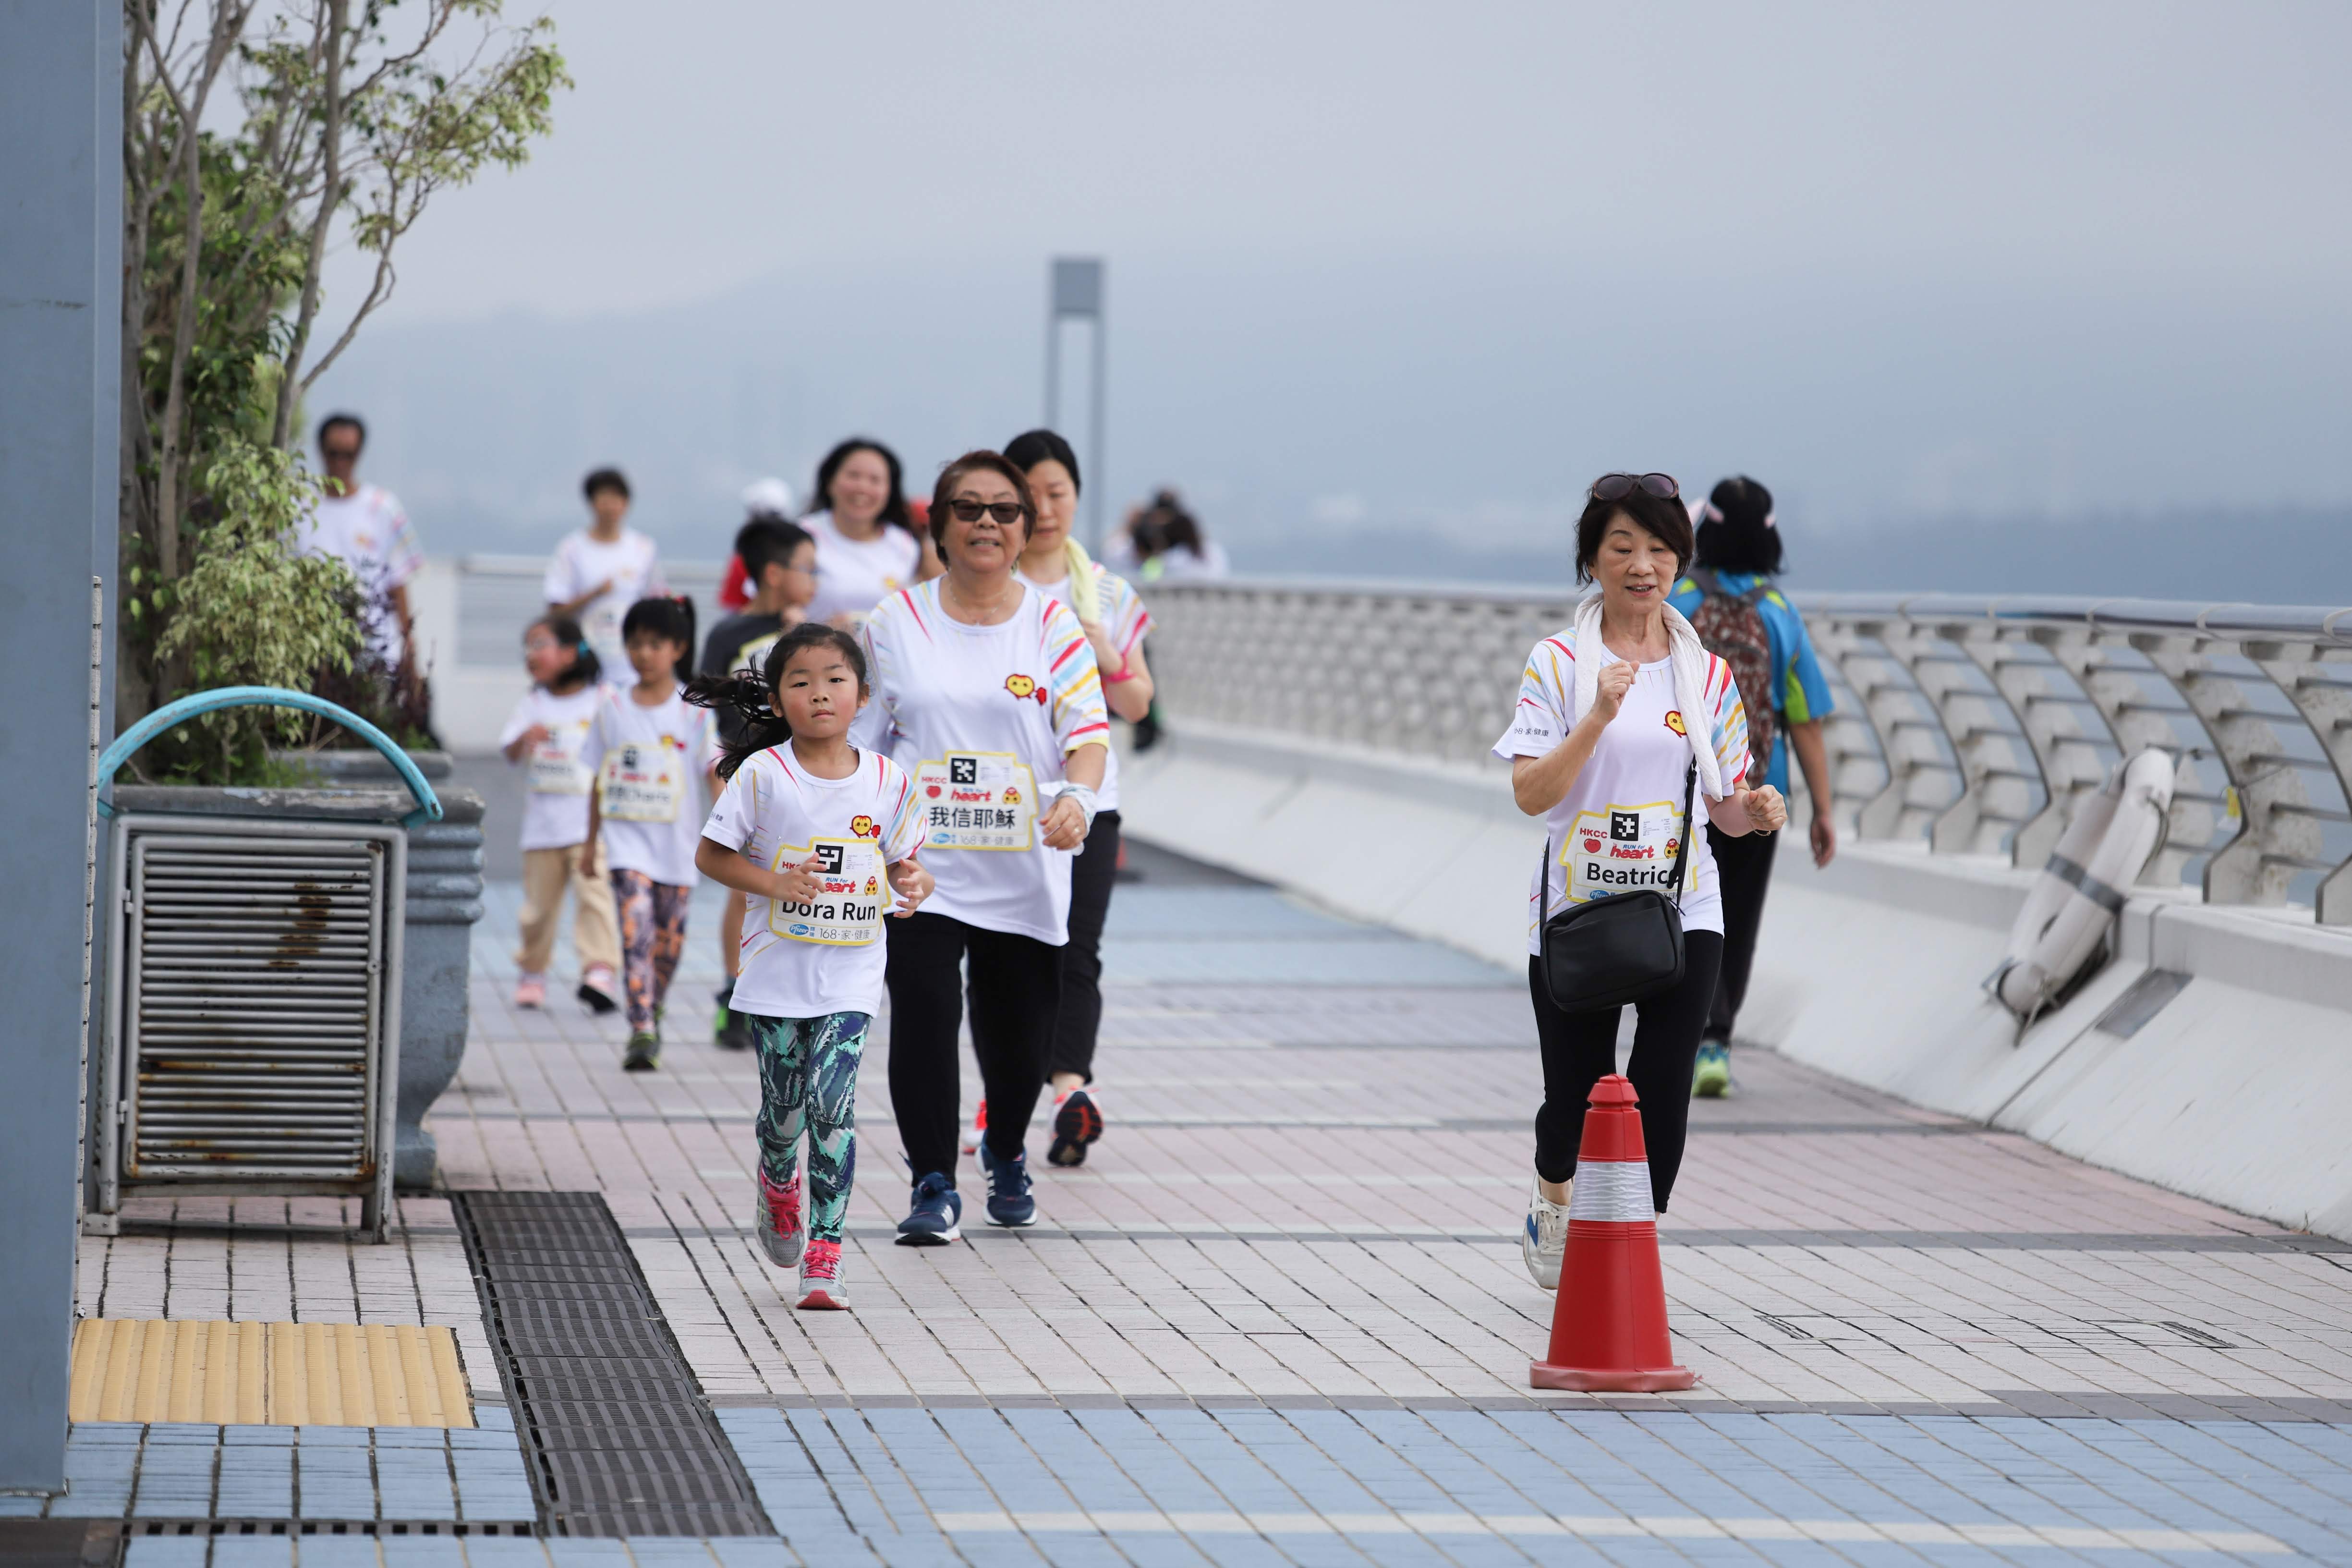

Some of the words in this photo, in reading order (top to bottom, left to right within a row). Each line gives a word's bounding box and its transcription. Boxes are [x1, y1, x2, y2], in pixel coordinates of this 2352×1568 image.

[951, 788, 991, 802] heart
[930, 806, 1016, 829] 我信耶穌
[1580, 827, 1608, 839] HKCC
[1610, 845, 1655, 859] heart
[825, 881, 856, 893] eart
[782, 901, 835, 920] Dora
[842, 902, 876, 921] Run
[790, 925, 809, 935] Pfizer
